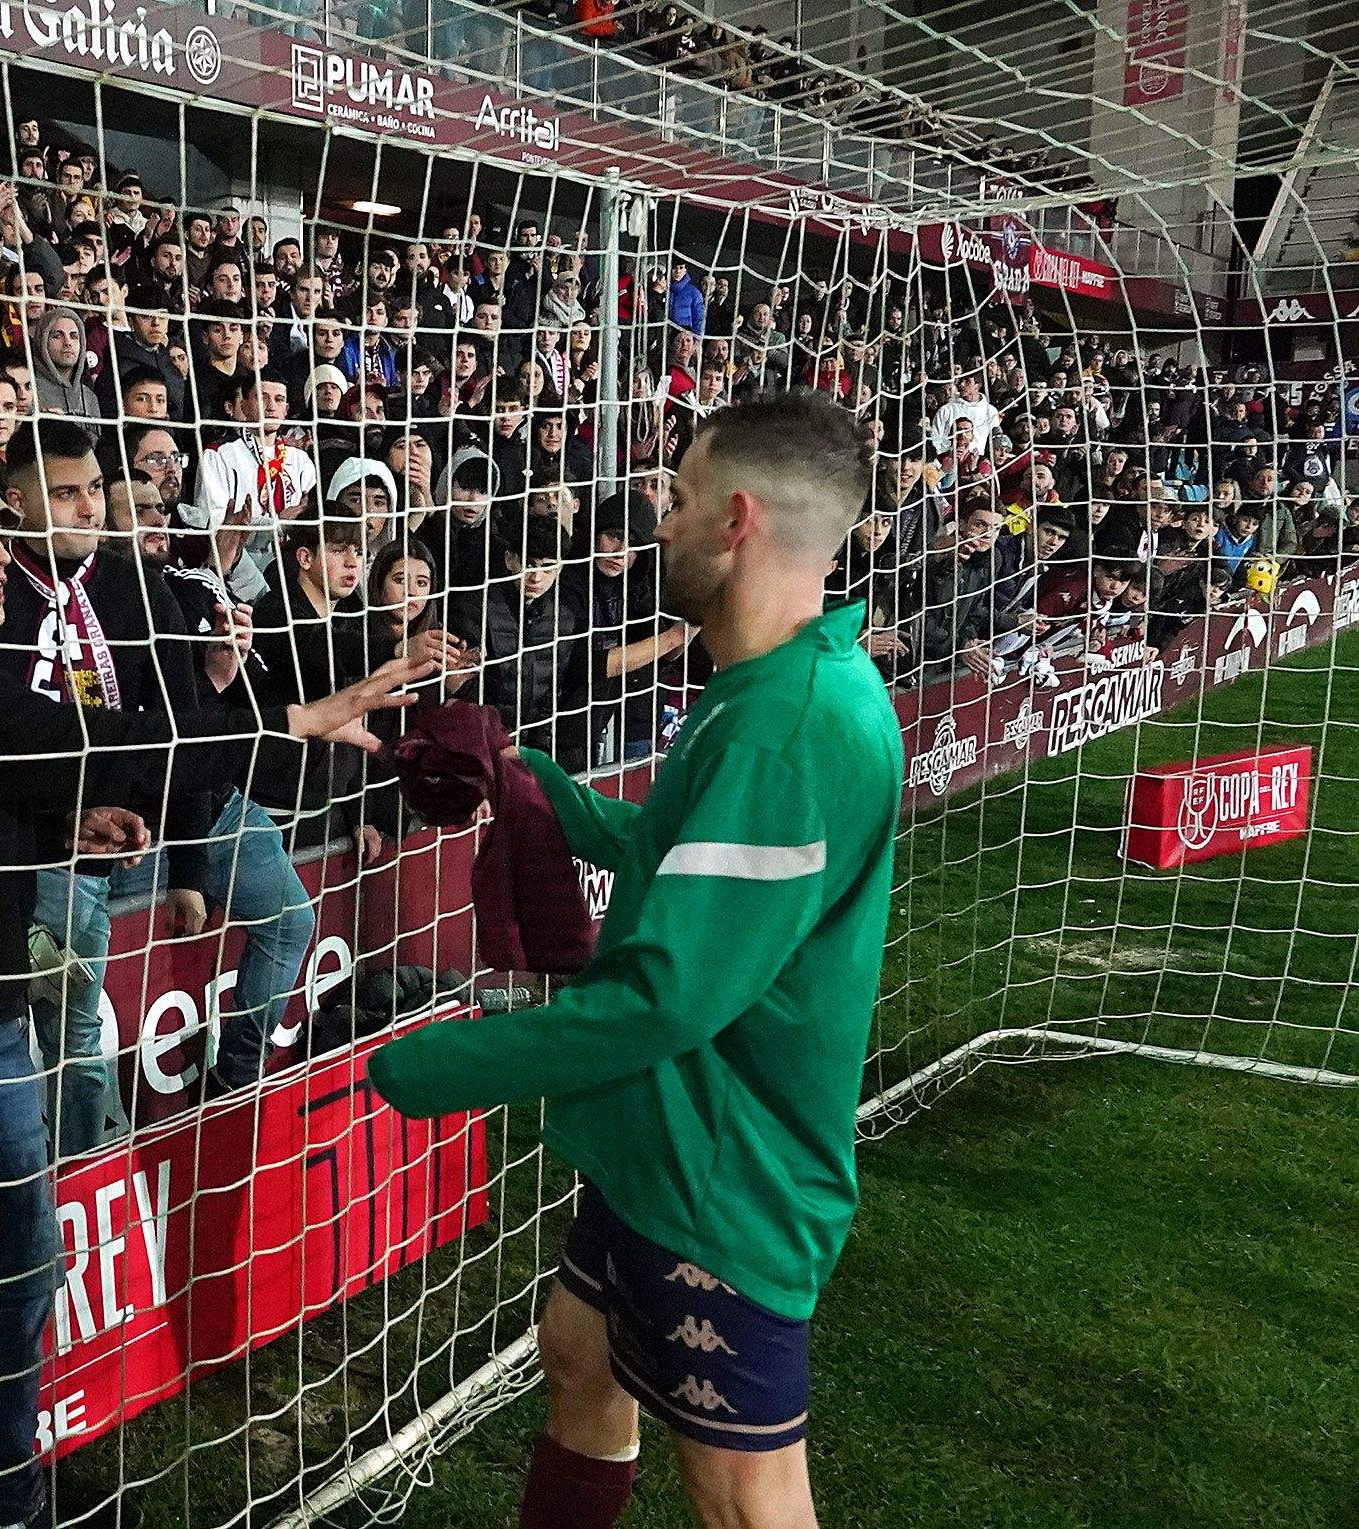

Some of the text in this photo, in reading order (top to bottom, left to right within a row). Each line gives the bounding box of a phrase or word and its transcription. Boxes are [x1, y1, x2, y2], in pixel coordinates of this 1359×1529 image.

[23, 0, 176, 76] Galicia
[327, 54, 436, 119] PUMAR
[1047, 660, 1164, 757] PESCAMAR
[909, 735, 977, 788] PESCAMAR
[1219, 769, 1260, 822] COPA
[1271, 763, 1299, 811] REY
[55, 1160, 172, 1356] REY
